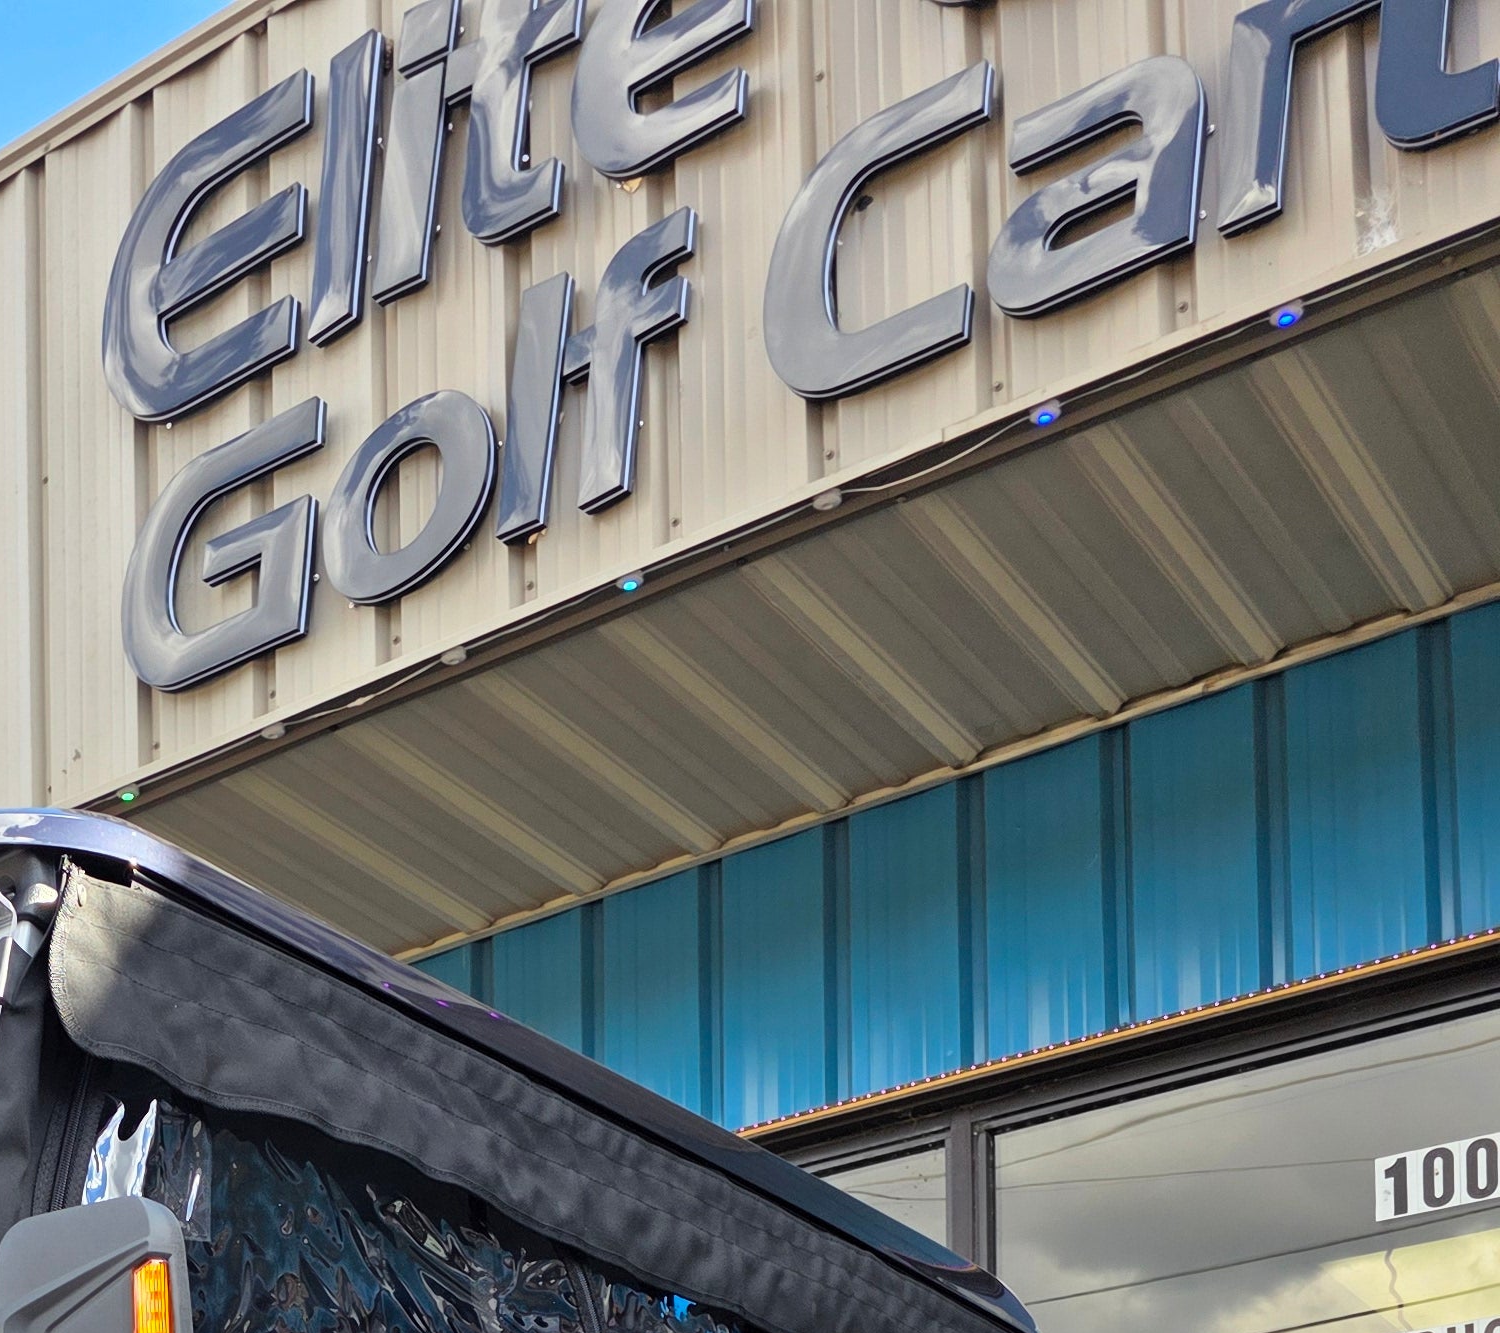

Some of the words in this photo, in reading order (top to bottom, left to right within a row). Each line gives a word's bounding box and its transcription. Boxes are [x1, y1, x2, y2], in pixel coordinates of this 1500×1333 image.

[103, 0, 753, 421] Elite
[122, 206, 698, 692] Golf
[1384, 1138, 1499, 1216] 100
